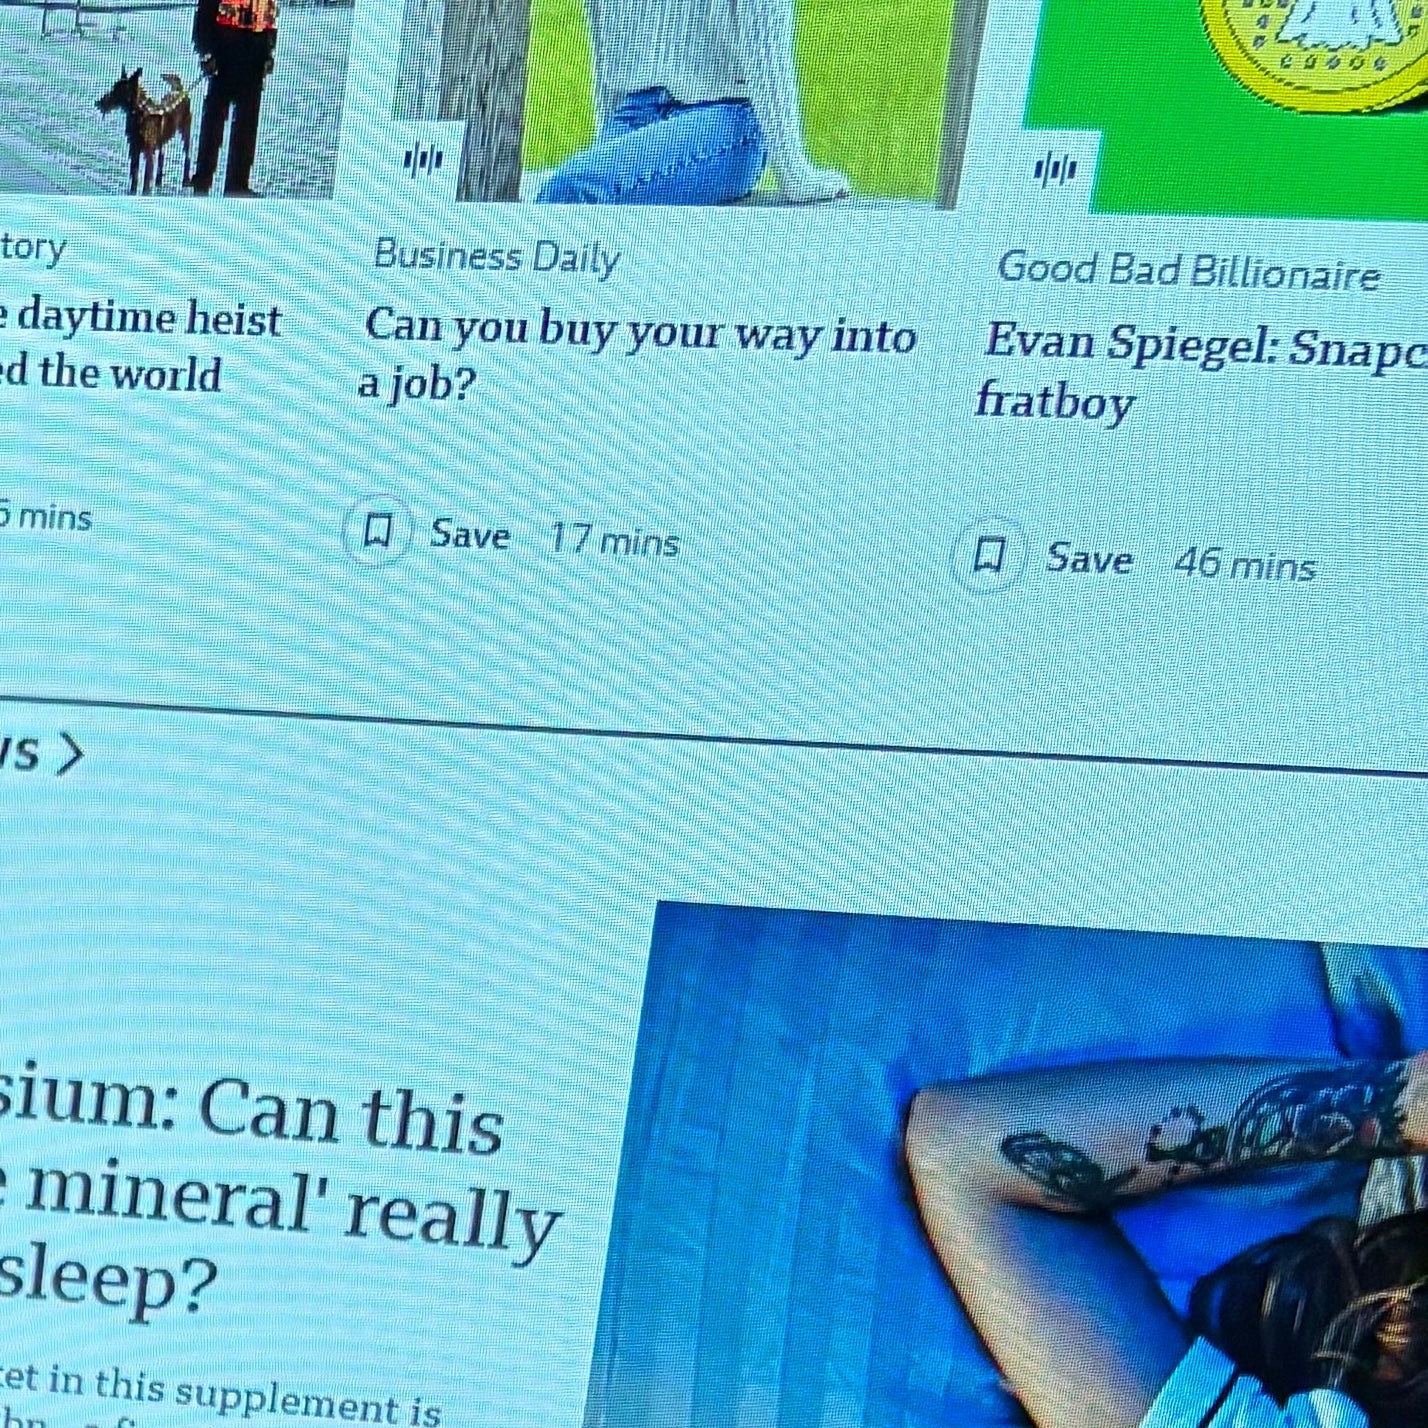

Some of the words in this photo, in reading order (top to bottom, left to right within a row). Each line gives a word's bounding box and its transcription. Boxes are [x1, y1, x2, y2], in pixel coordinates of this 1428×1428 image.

[374, 238, 521, 273] Business
[533, 240, 620, 279] Daily
[998, 250, 1099, 285] Good
[1110, 251, 1180, 287] Bad
[1190, 254, 1381, 293] Billionaire
[17, 293, 176, 340] daytime
[185, 299, 283, 337] heist
[366, 305, 447, 345] Can
[453, 314, 529, 354] you
[539, 307, 620, 357] buy
[627, 318, 725, 362] your
[735, 320, 823, 360] way
[831, 316, 918, 356] into
[985, 318, 1094, 359] Evan
[1106, 323, 1277, 373] Spiegel:
[38, 351, 101, 389] the
[111, 352, 222, 394] world
[358, 371, 382, 401] a
[387, 364, 477, 409] job?
[975, 380, 1137, 430] fratboy
[18, 502, 93, 532] mins
[430, 520, 510, 551] Save
[550, 520, 593, 554] 17
[599, 526, 680, 558] mins
[1047, 543, 1134, 575] Save
[1174, 546, 1222, 579] 46
[1230, 550, 1316, 583] mins
[199, 1077, 339, 1144] Can
[361, 1088, 504, 1155] this
[27, 1157, 329, 1234] mineral'
[344, 1184, 563, 1268] really
[48, 1361, 86, 1395] in
[95, 1366, 165, 1402] this
[175, 1375, 399, 1425] supplement
[409, 1397, 442, 1428] is
